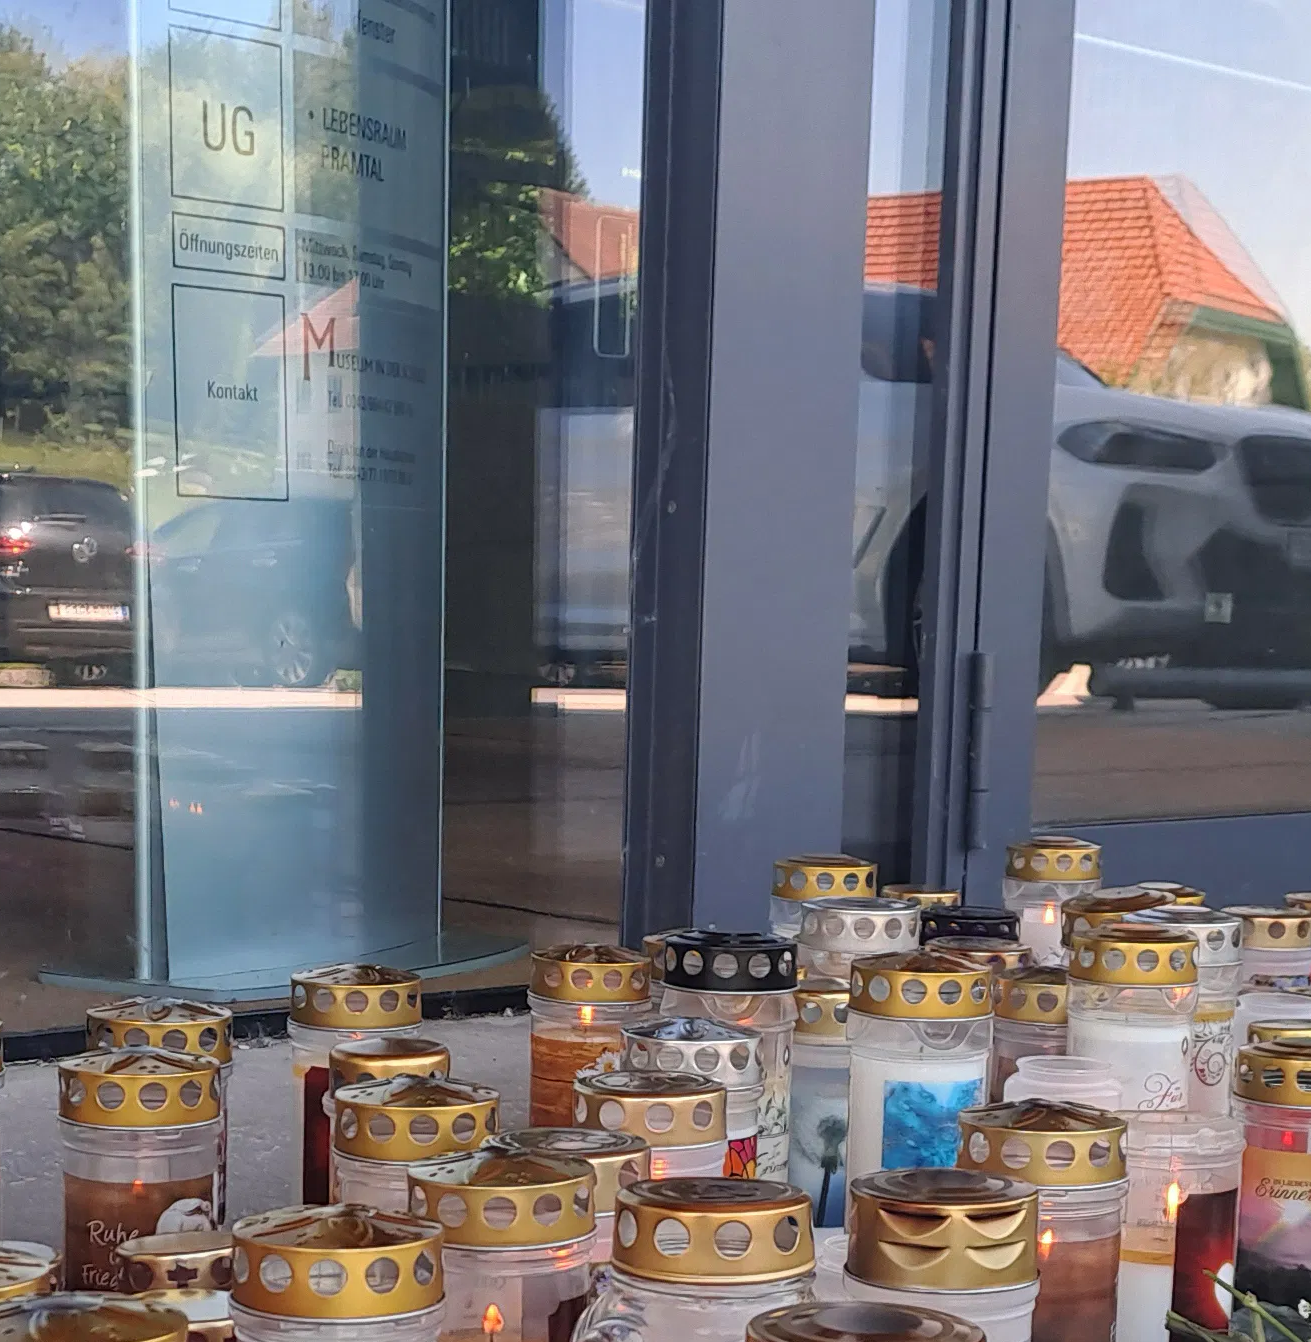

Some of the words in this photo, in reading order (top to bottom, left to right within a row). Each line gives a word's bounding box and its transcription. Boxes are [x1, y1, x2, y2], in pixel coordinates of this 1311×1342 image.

[202, 99, 255, 156] UG
[322, 107, 407, 152] LEBENSRAUM
[320, 144, 385, 182] PRAMTAL
[179, 228, 279, 262] Öffnungszeiten
[206, 380, 259, 403] Kontakt
[86, 1220, 139, 1246] Ruhe
